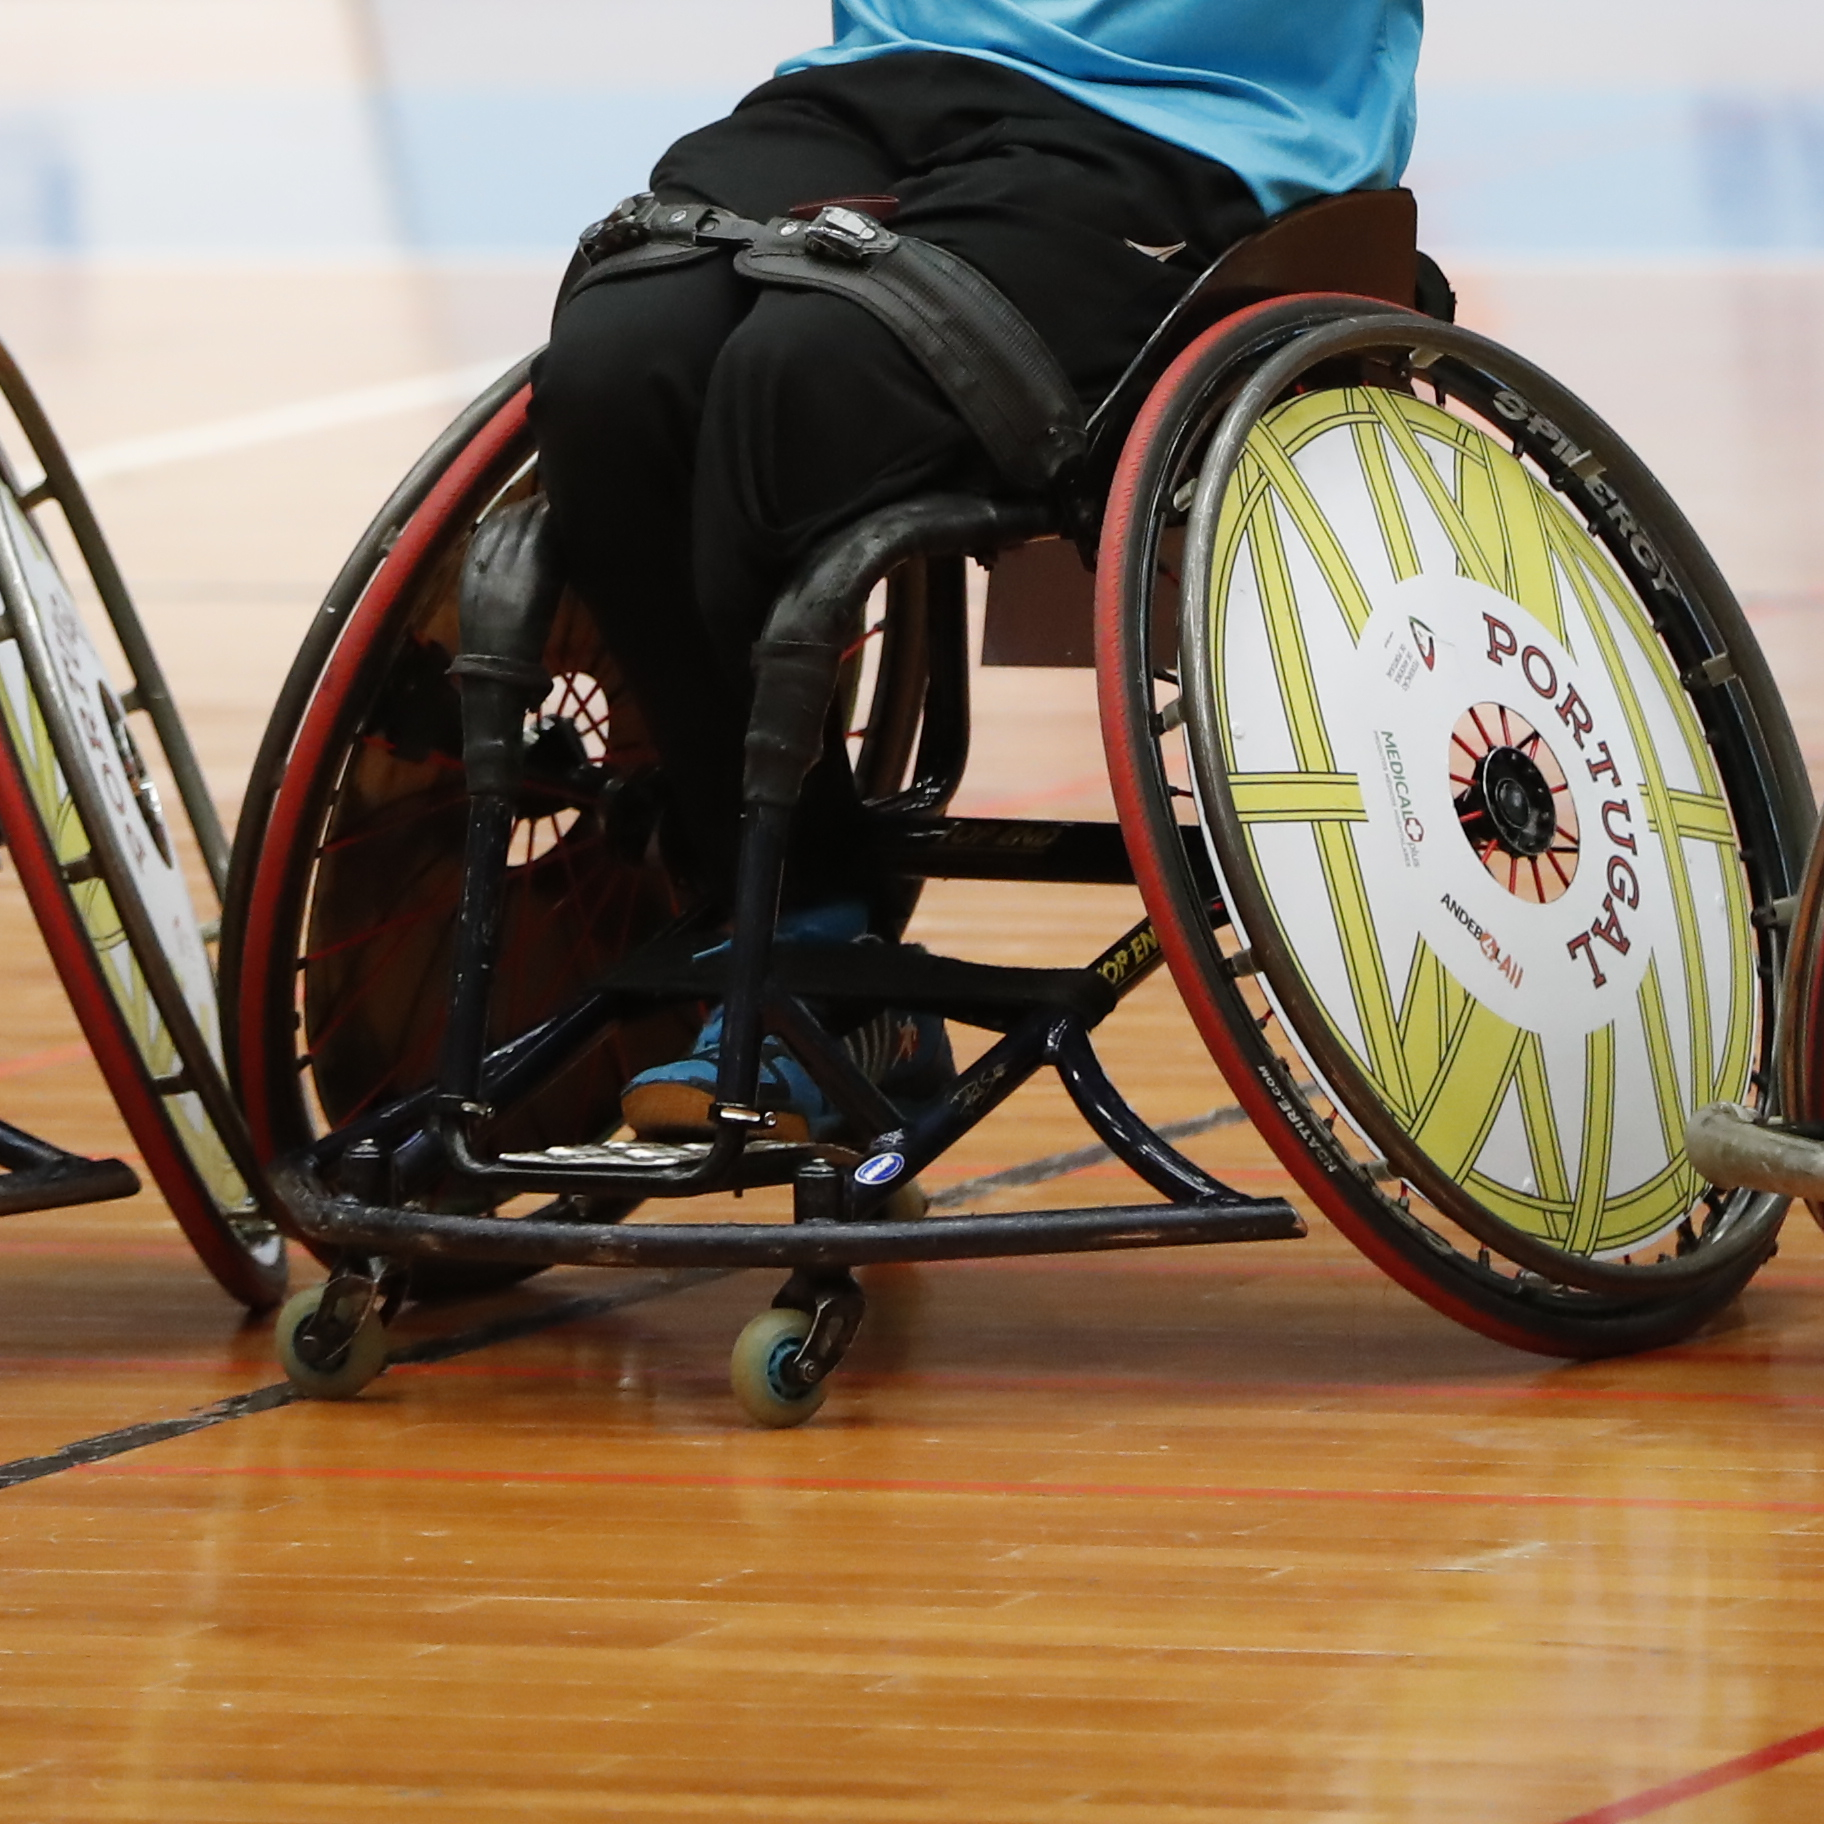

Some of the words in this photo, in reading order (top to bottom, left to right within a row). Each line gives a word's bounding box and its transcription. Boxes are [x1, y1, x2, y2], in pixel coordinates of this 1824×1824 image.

[1380, 730, 1414, 821] MEDICAL
[1482, 611, 1640, 989] PORTUGAL
[1097, 949, 1129, 984] OP
